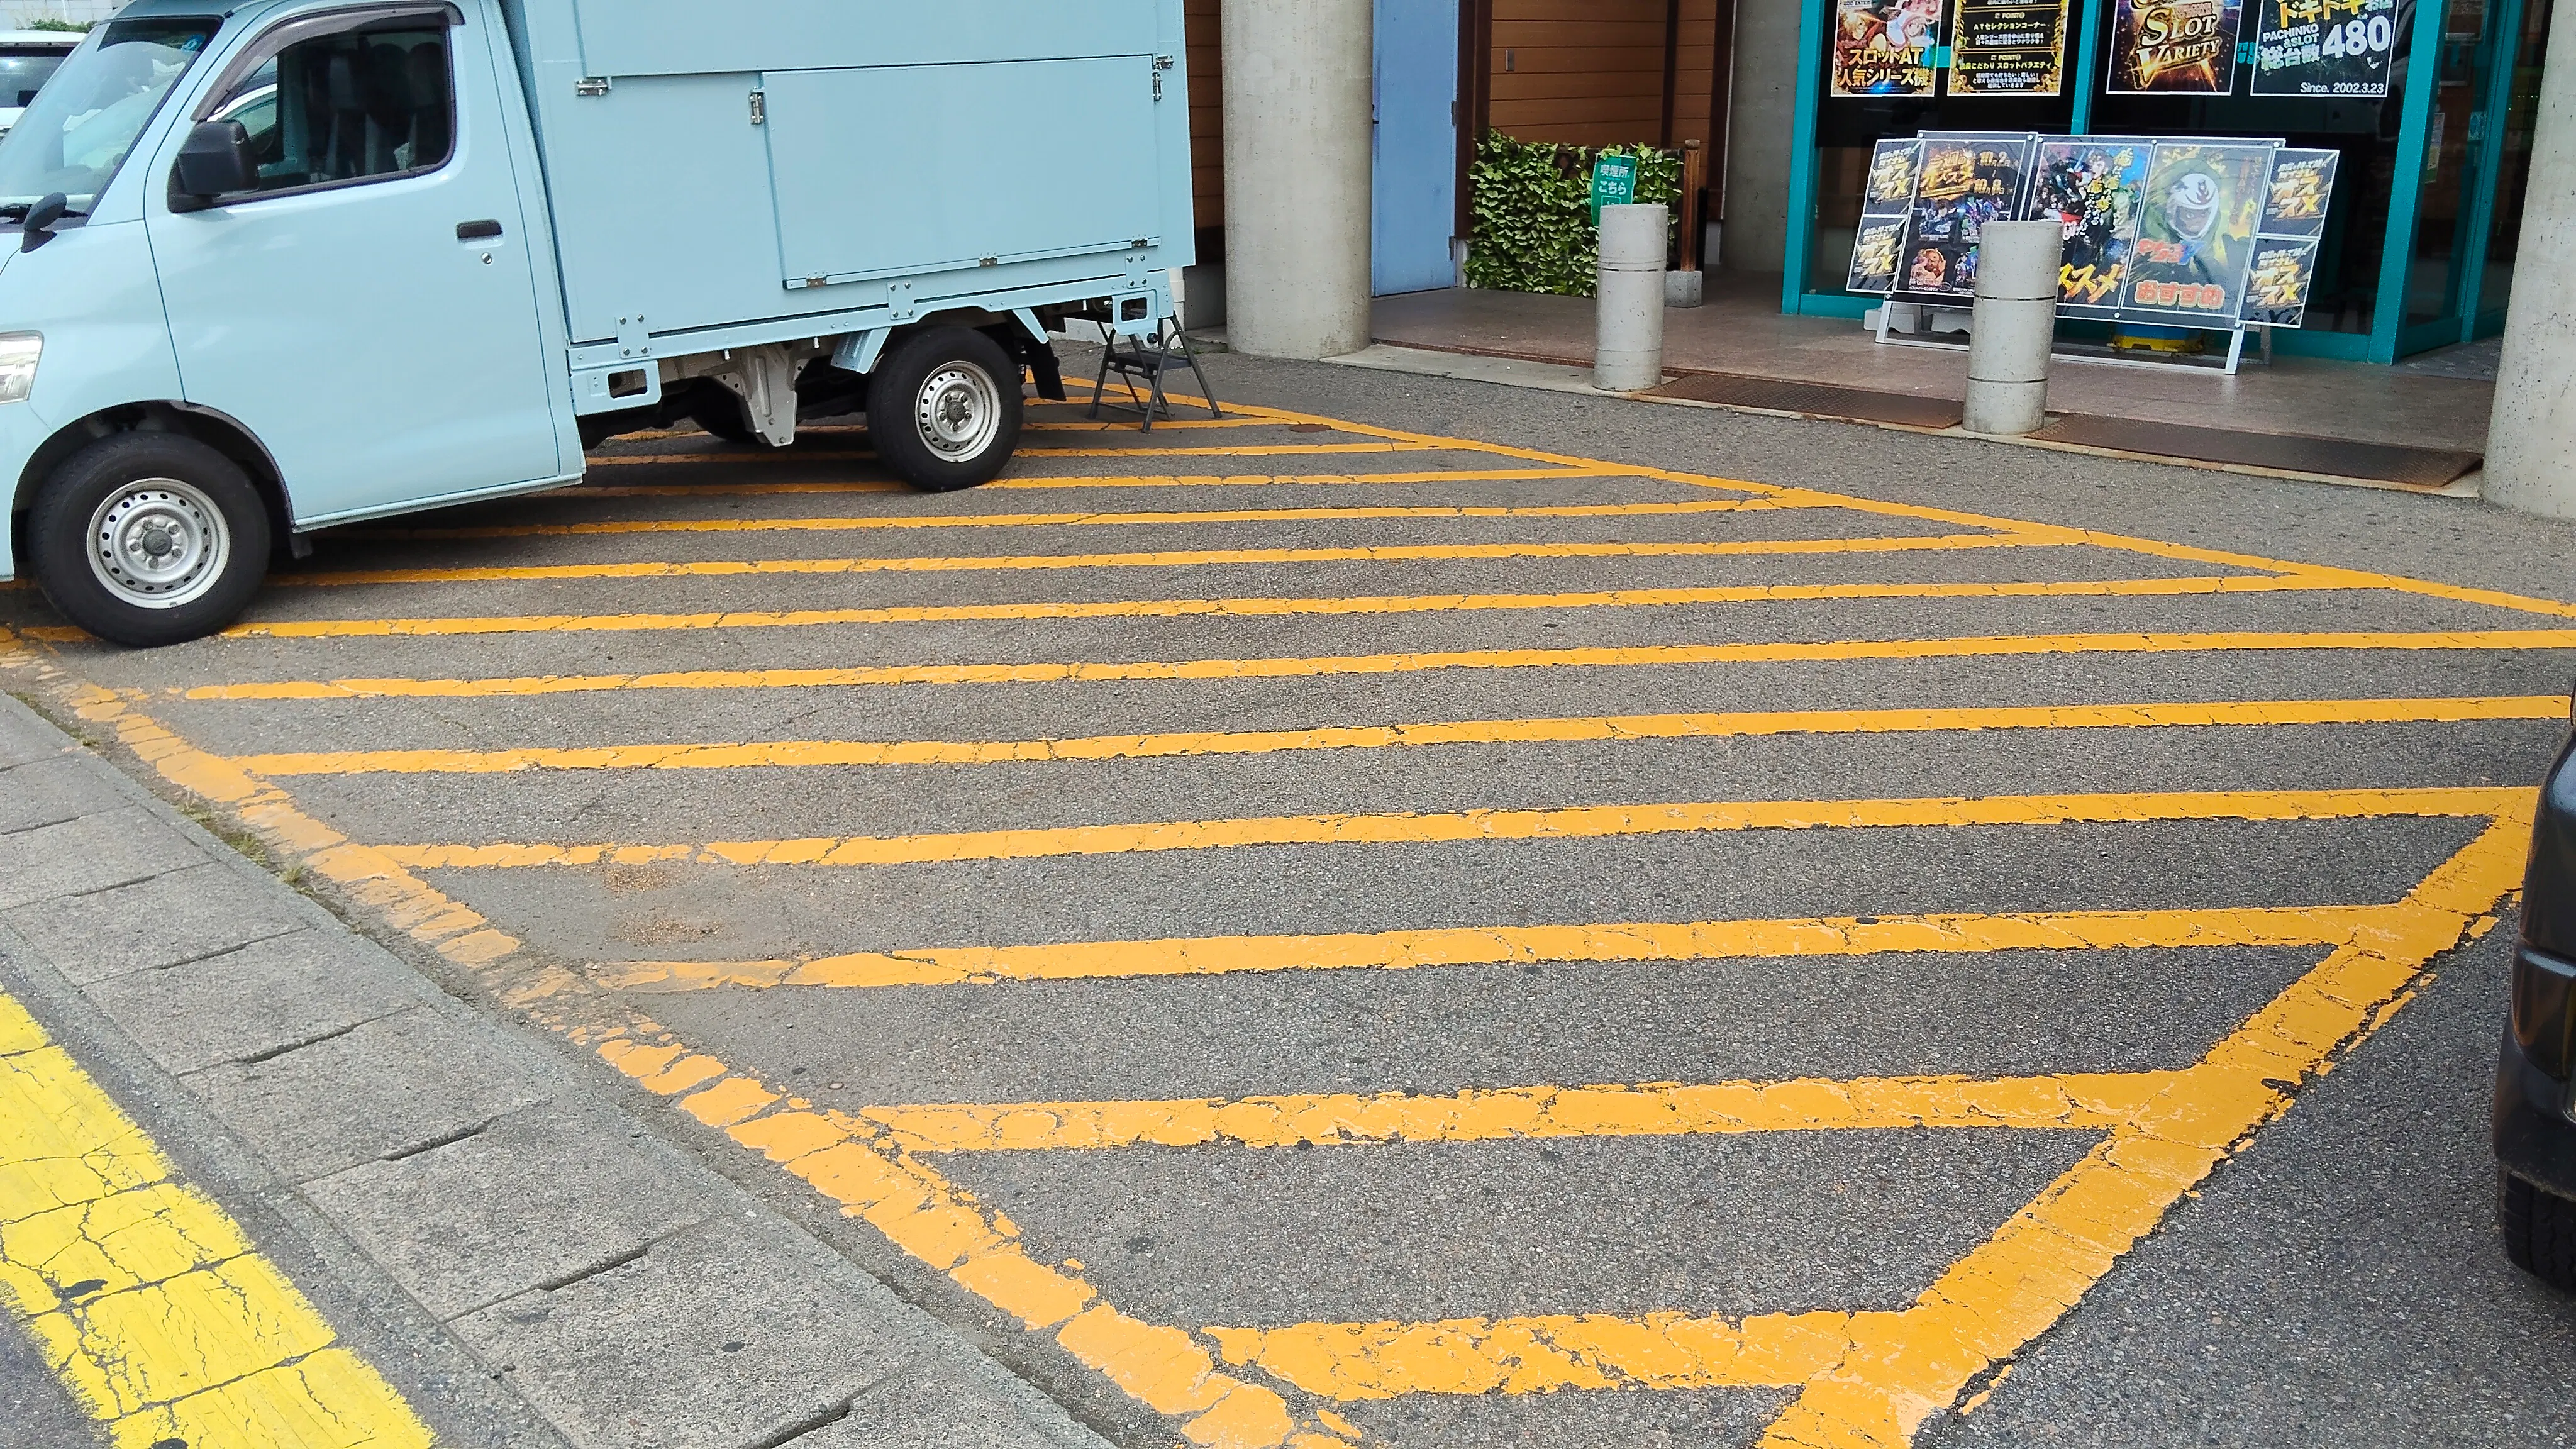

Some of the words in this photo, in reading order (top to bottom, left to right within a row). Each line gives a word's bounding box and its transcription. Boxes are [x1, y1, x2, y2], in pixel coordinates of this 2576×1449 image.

[2141, 7, 2216, 46] SLOT
[2262, 23, 2319, 42] PACHINKO
[2322, 16, 2391, 58] 480
[2283, 33, 2319, 48] &SLOT
[1848, 47, 1924, 65] スロットAT
[2136, 39, 2220, 82] VARIETY
[2259, 43, 2321, 70] 総台数
[1837, 65, 1930, 87] 人気シリーズ機
[2300, 82, 2329, 94] Since.
[2333, 82, 2384, 94] 2002.3.23
[1598, 180, 1627, 196] こちら
[2135, 280, 2226, 309] おすすめ
